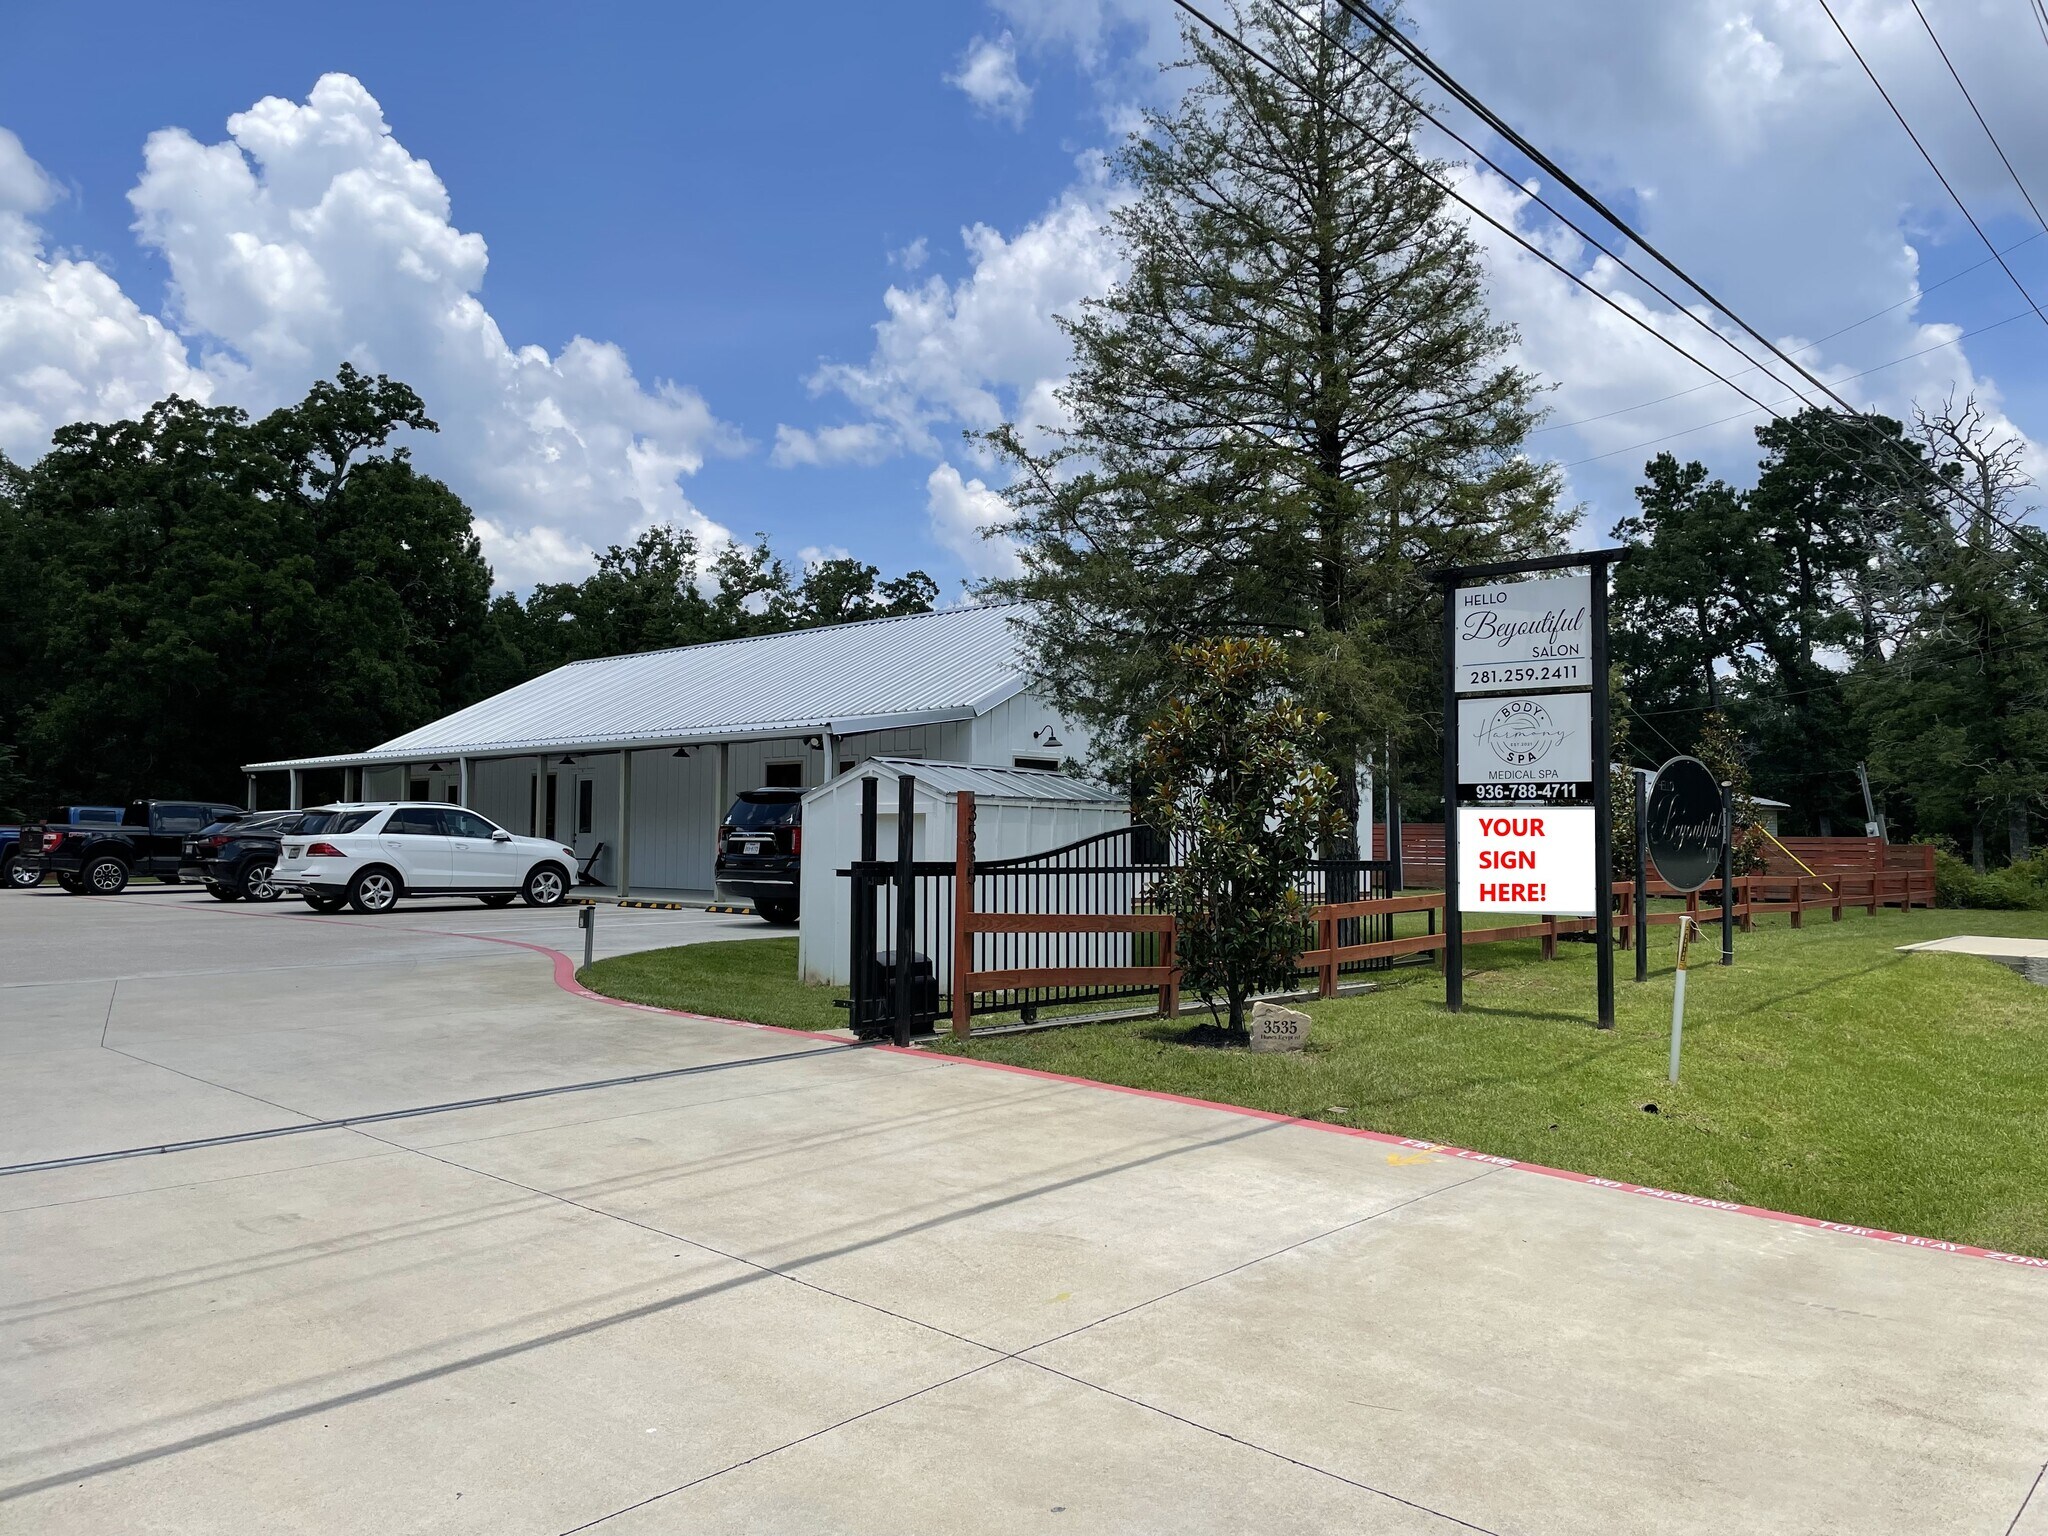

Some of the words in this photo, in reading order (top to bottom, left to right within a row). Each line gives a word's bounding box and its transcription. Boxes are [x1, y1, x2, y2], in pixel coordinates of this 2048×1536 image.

[1464, 592, 1507, 606] HELLO
[1462, 607, 1585, 647] Beyoutiful
[1532, 644, 1579, 658] SALON
[1470, 666, 1577, 684] 281.259.2411
[1501, 702, 1542, 717] BODY
[1473, 719, 1575, 746] Harmony
[1507, 752, 1537, 763] SPA
[1488, 770, 1536, 779] MEDICAL
[1538, 769, 1559, 779] SPA
[1476, 783, 1577, 799] 936-788-4711
[1263, 1020, 1298, 1034] 3535
[1399, 1138, 1448, 1152] FIRE
[1456, 1151, 1521, 1167] LANE
[1586, 1177, 1623, 1188] NO
[1634, 1187, 1741, 1210] PARKING
[1819, 1221, 1873, 1236] TOW
[1890, 1234, 1966, 1252] AWAY
[1983, 1251, 2048, 1267] ZON
